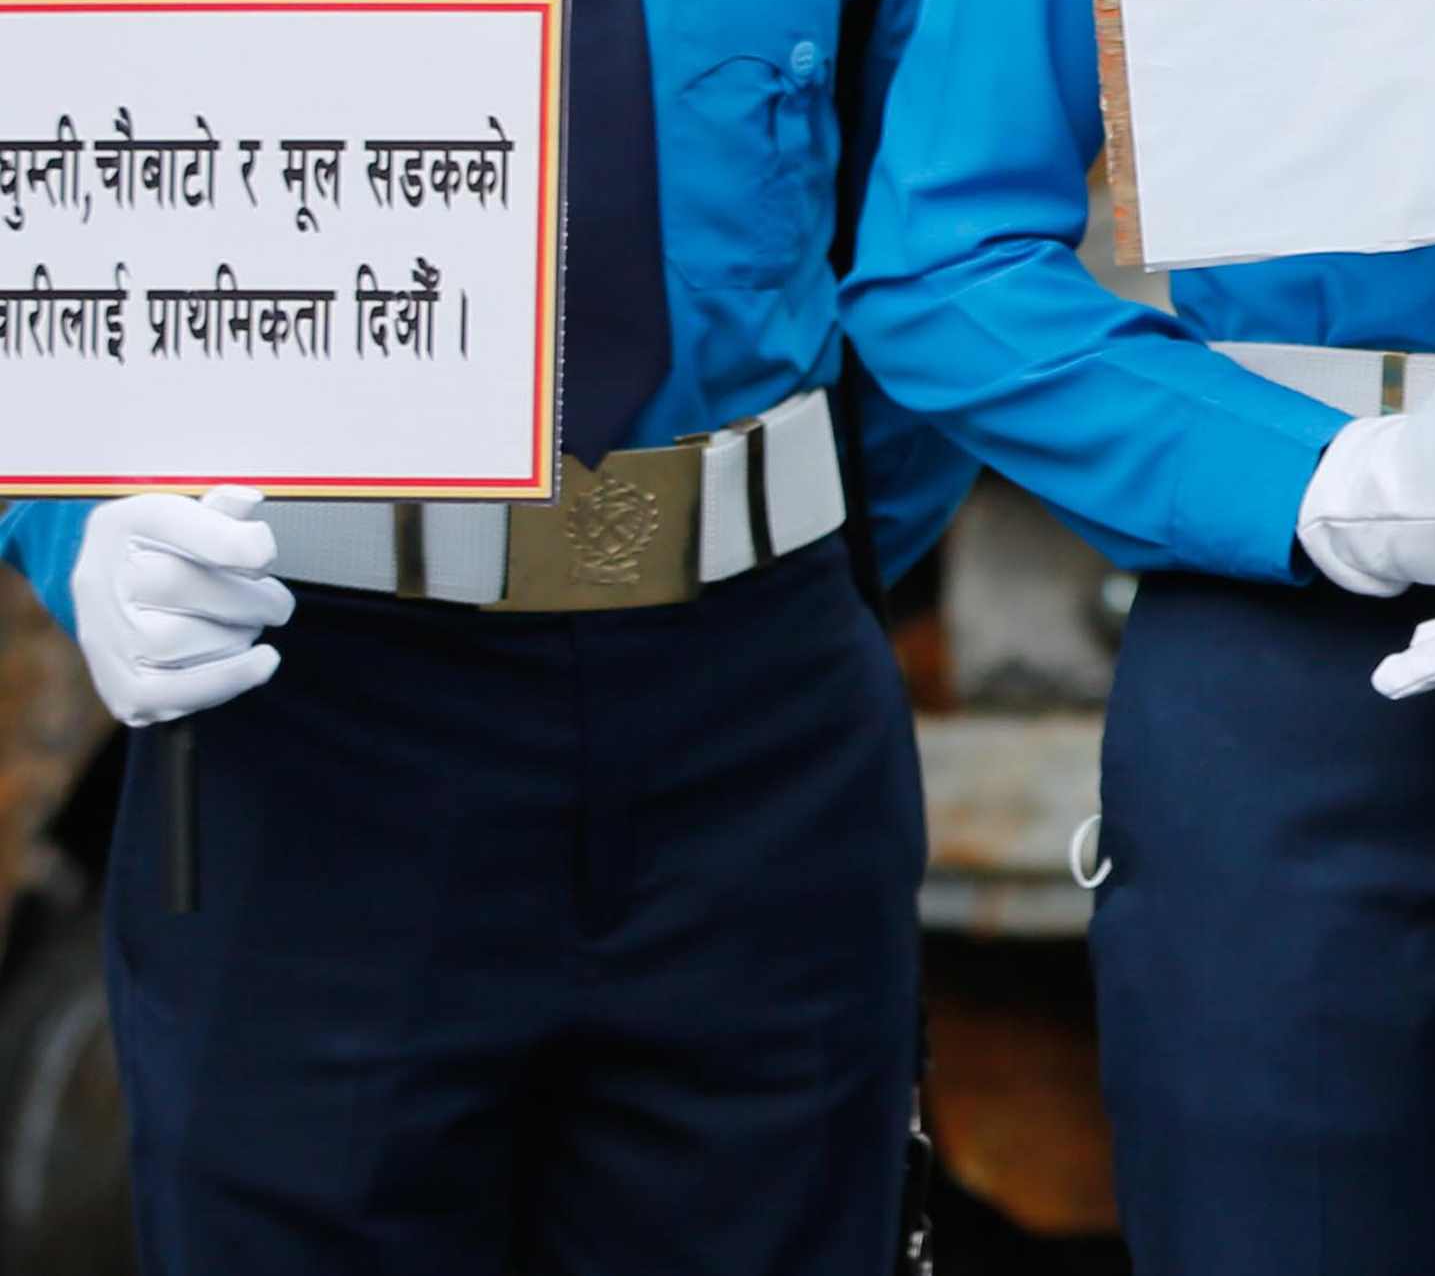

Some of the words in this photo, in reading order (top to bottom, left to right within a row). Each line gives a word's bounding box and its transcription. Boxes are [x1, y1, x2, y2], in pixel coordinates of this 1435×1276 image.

[238, 139, 262, 206] र
[279, 139, 347, 232] मूल
[364, 115, 515, 208] सडकको
[145, 262, 337, 357] प्राथमिकता
